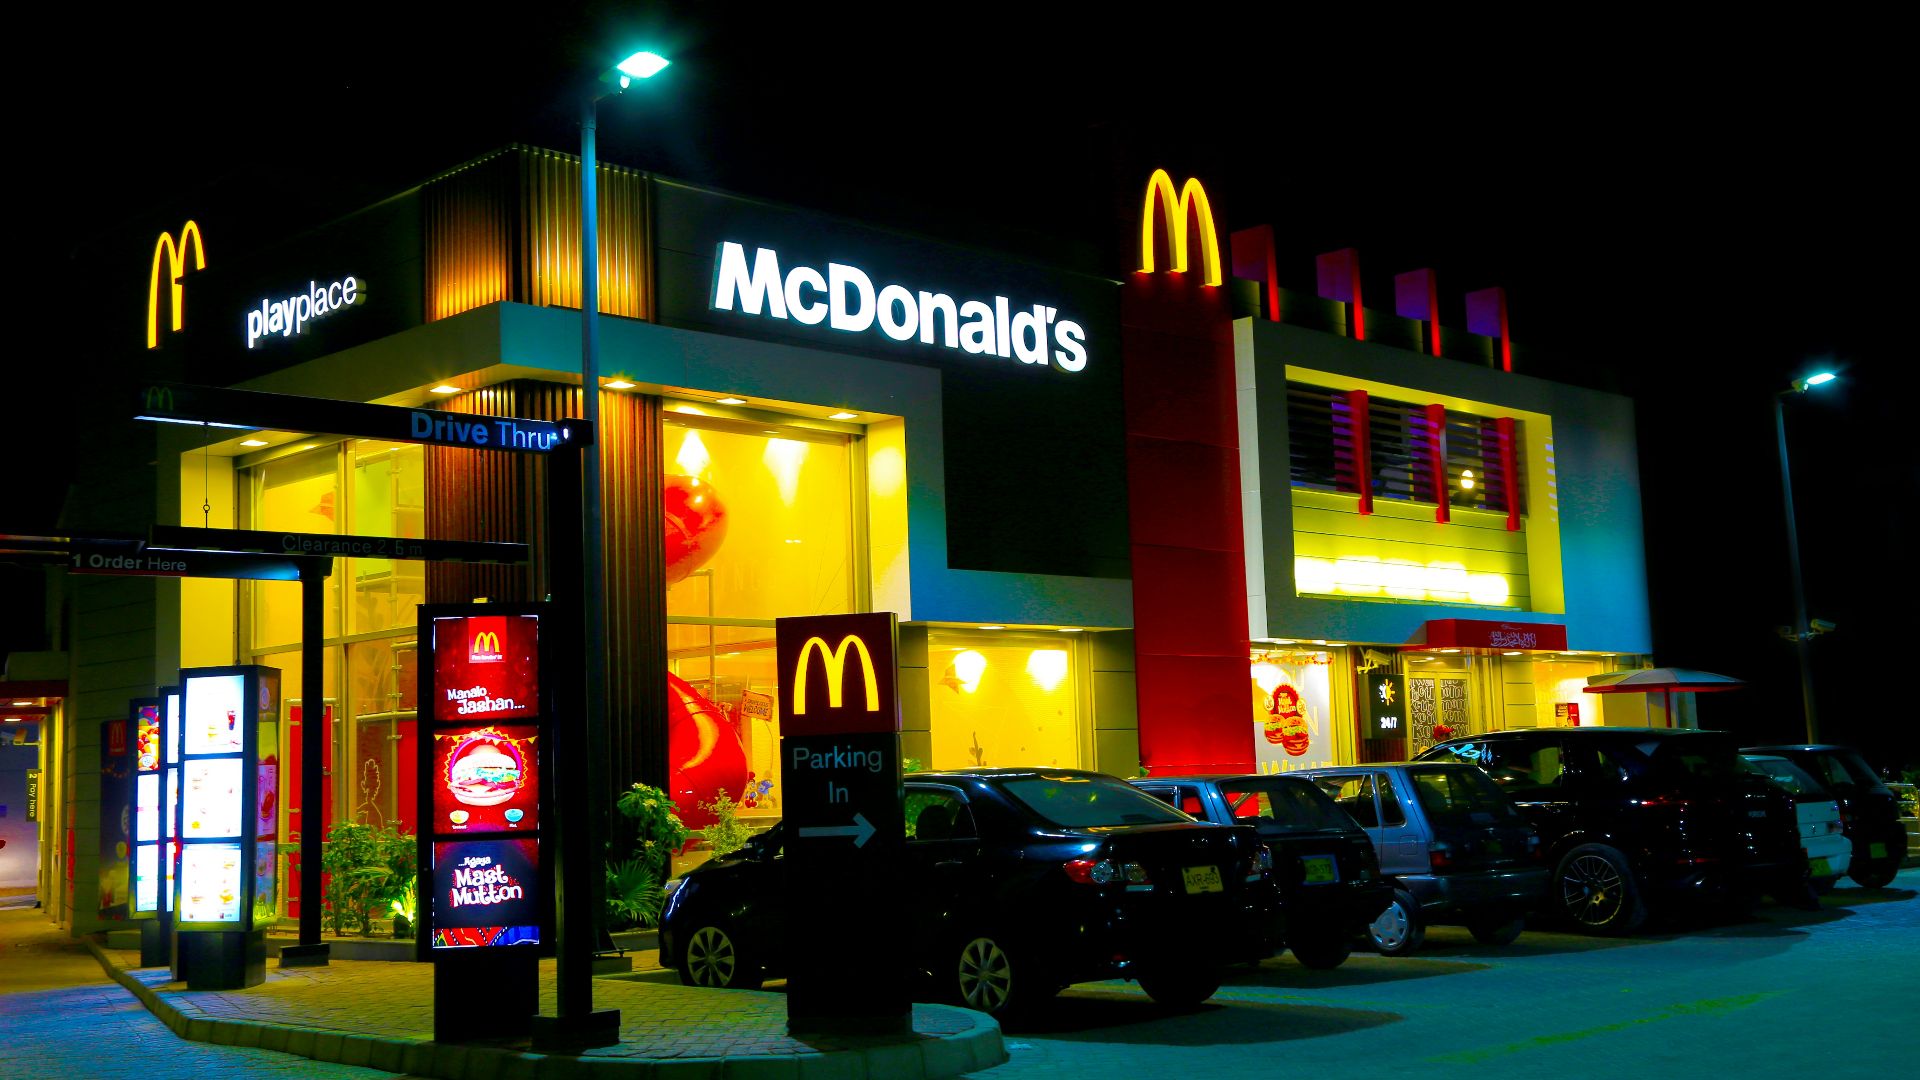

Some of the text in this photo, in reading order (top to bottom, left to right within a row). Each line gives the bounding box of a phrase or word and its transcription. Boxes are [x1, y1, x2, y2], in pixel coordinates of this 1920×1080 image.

[246, 275, 358, 349] playplace
[712, 240, 1088, 374] McDonald's
[410, 411, 552, 451] Drive Thru
[282, 534, 372, 553] Clearance
[72, 554, 187, 571] 1 Order Here
[447, 685, 487, 700] Manalo
[1379, 716, 1398, 729] 24/7
[792, 746, 883, 774] Parking
[28, 783, 37, 797] Pay
[829, 781, 849, 804] In
[29, 799, 37, 818] here
[454, 864, 509, 889] Mast
[451, 884, 522, 908] Mutton
